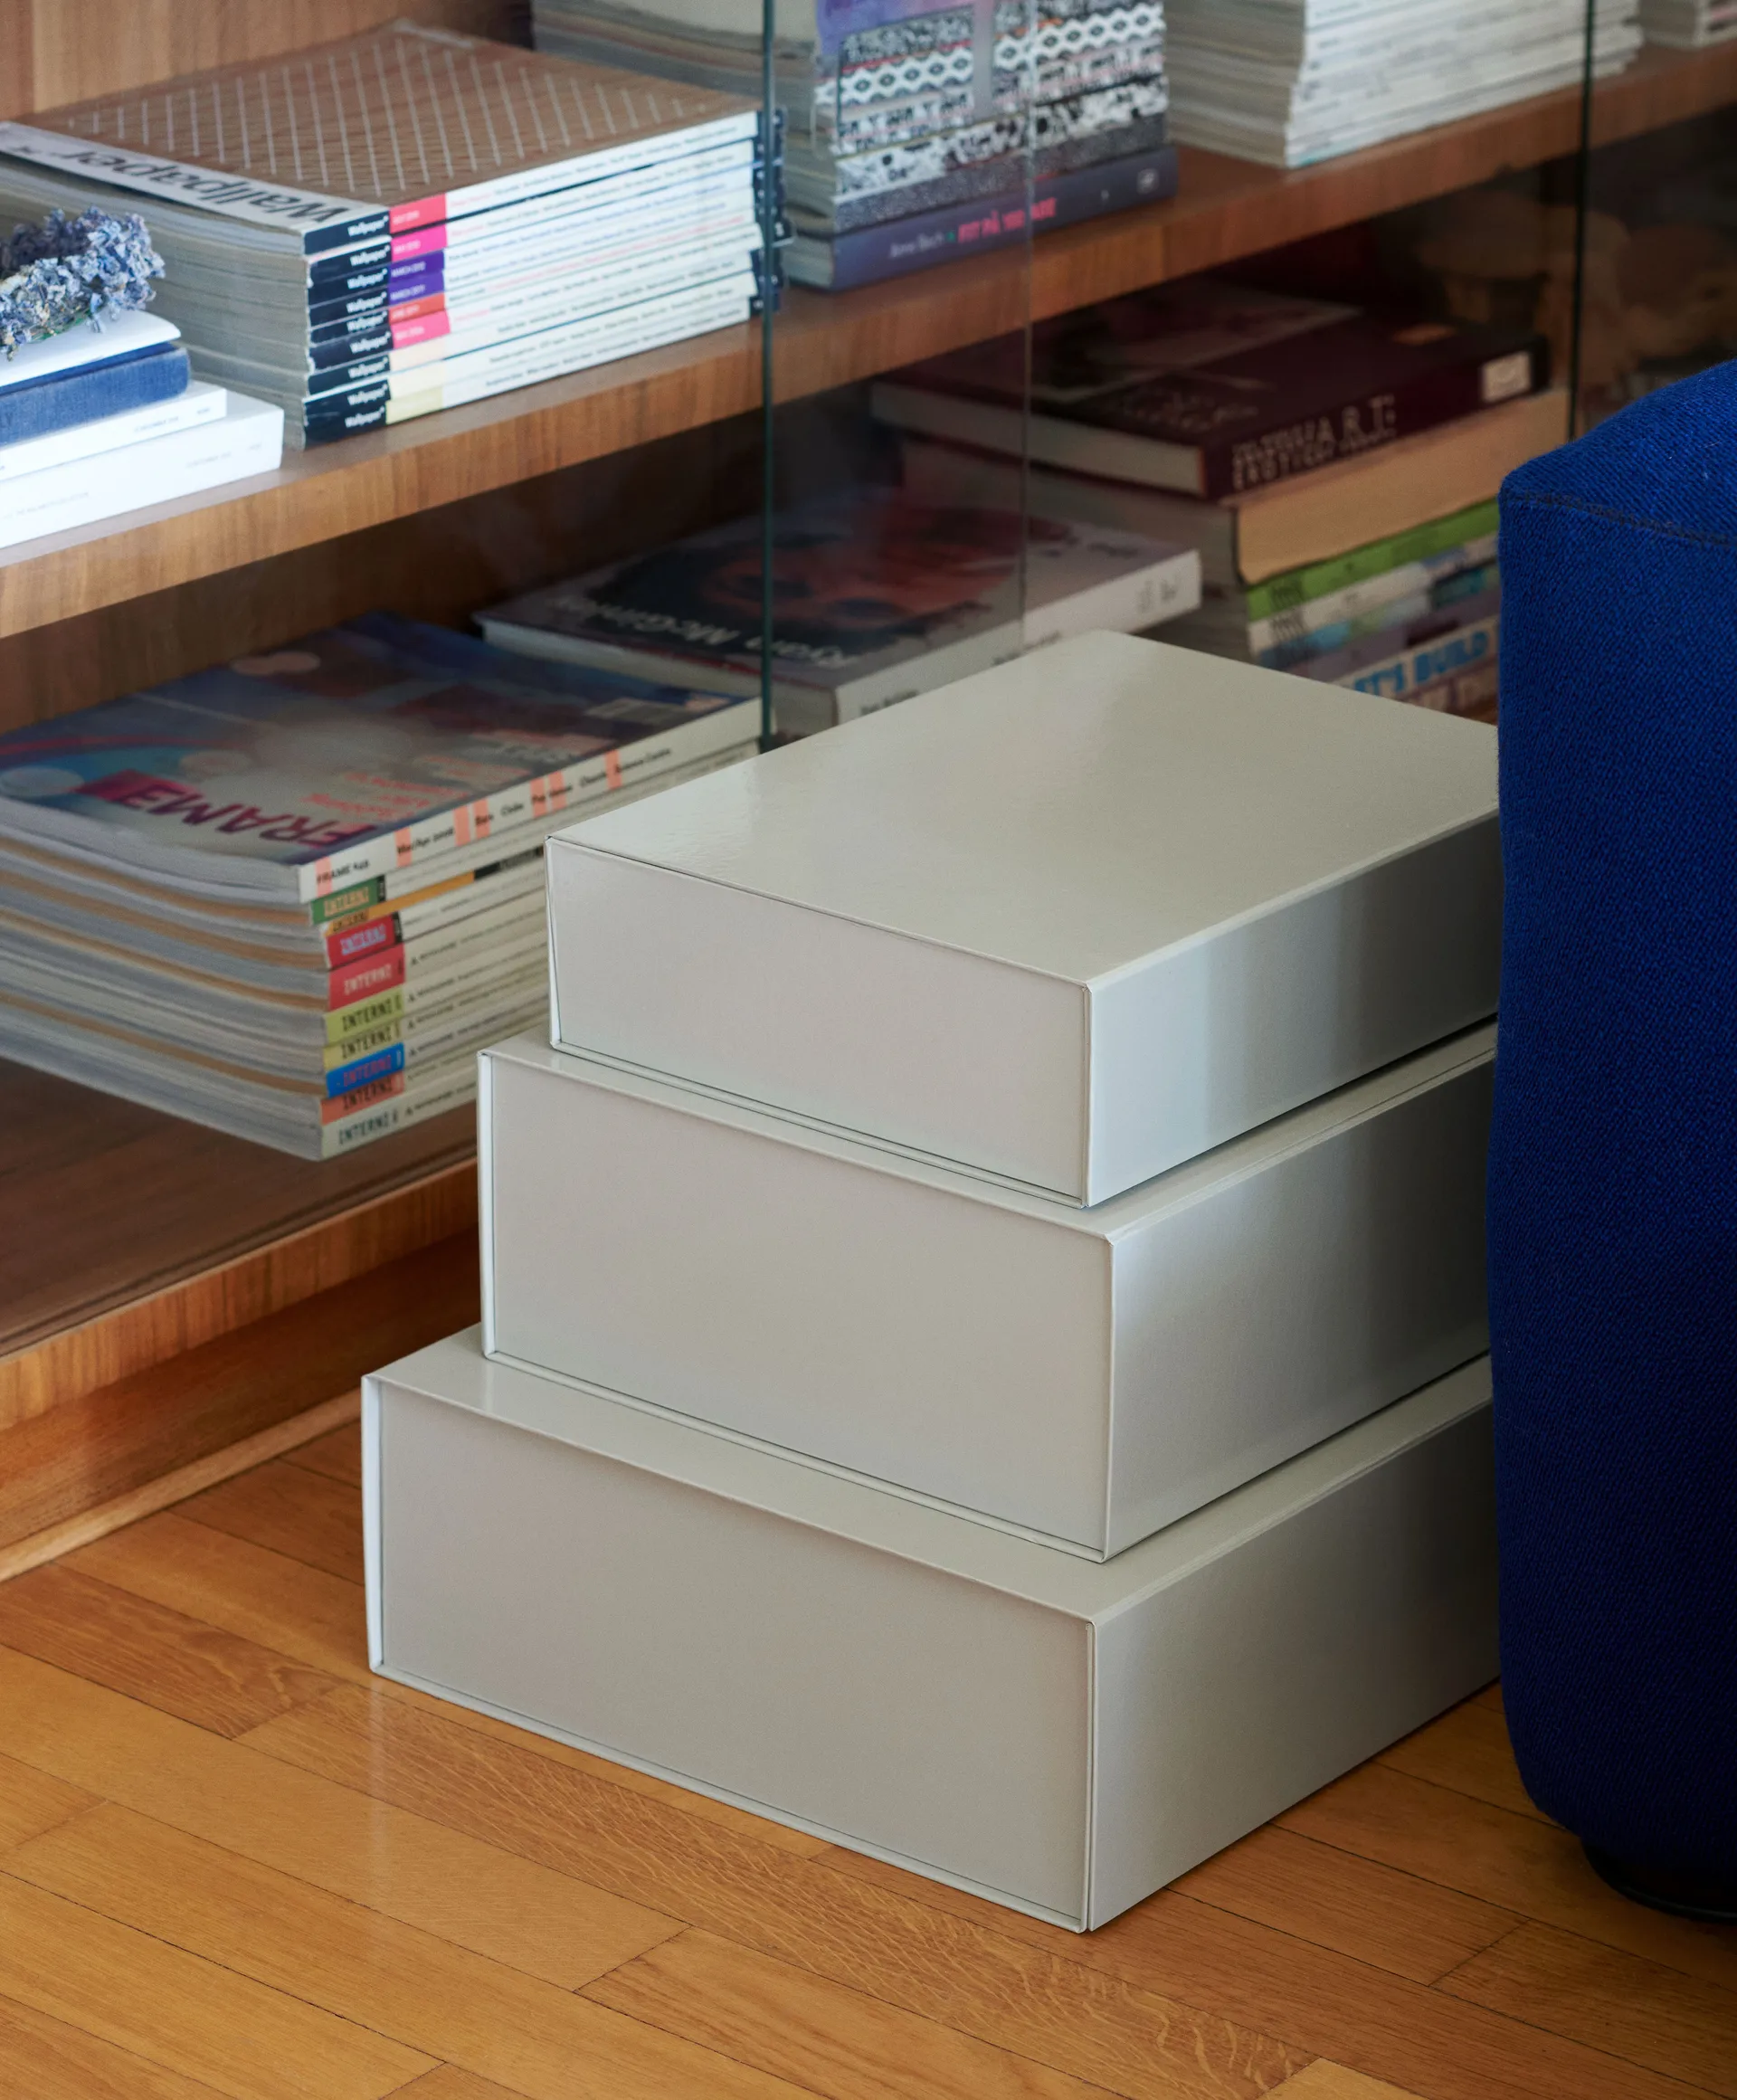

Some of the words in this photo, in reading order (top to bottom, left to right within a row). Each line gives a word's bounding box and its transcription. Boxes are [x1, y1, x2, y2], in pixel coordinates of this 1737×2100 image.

[118, 783, 377, 849] FRAME
[344, 963, 393, 995] INTERNI
[342, 998, 393, 1032] INTERNI
[341, 1024, 392, 1060] INTERNI
[343, 1055, 392, 1088] INTERNI
[343, 1078, 394, 1111] INTERNI
[338, 1110, 390, 1146] INTERNI
